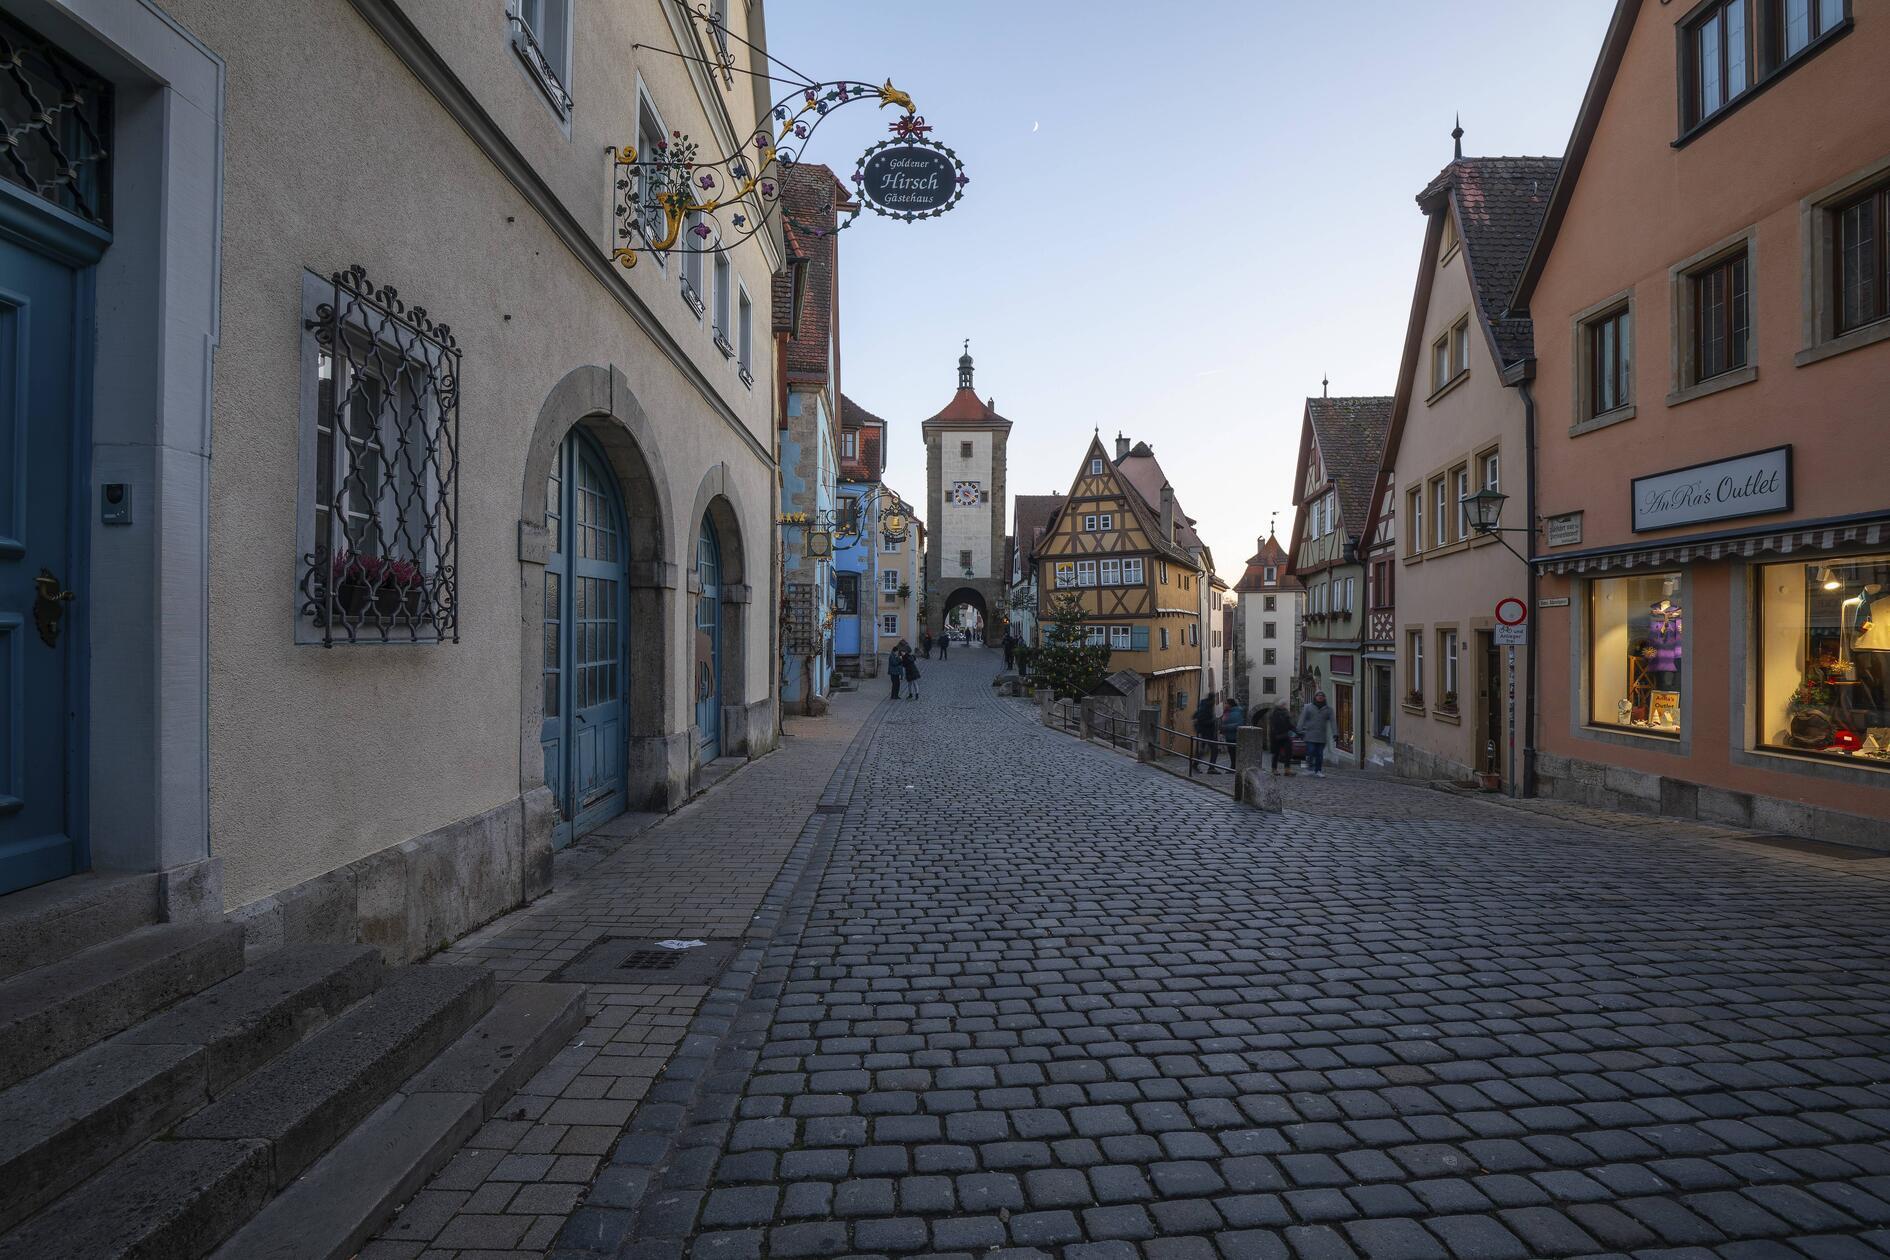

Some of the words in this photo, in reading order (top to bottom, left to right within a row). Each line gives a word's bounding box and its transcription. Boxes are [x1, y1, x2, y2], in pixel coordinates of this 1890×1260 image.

[889, 158, 929, 169] Goldener
[880, 172, 938, 190] Hirsch
[884, 192, 934, 205] Gästehaus
[1716, 469, 1780, 503] Outlet
